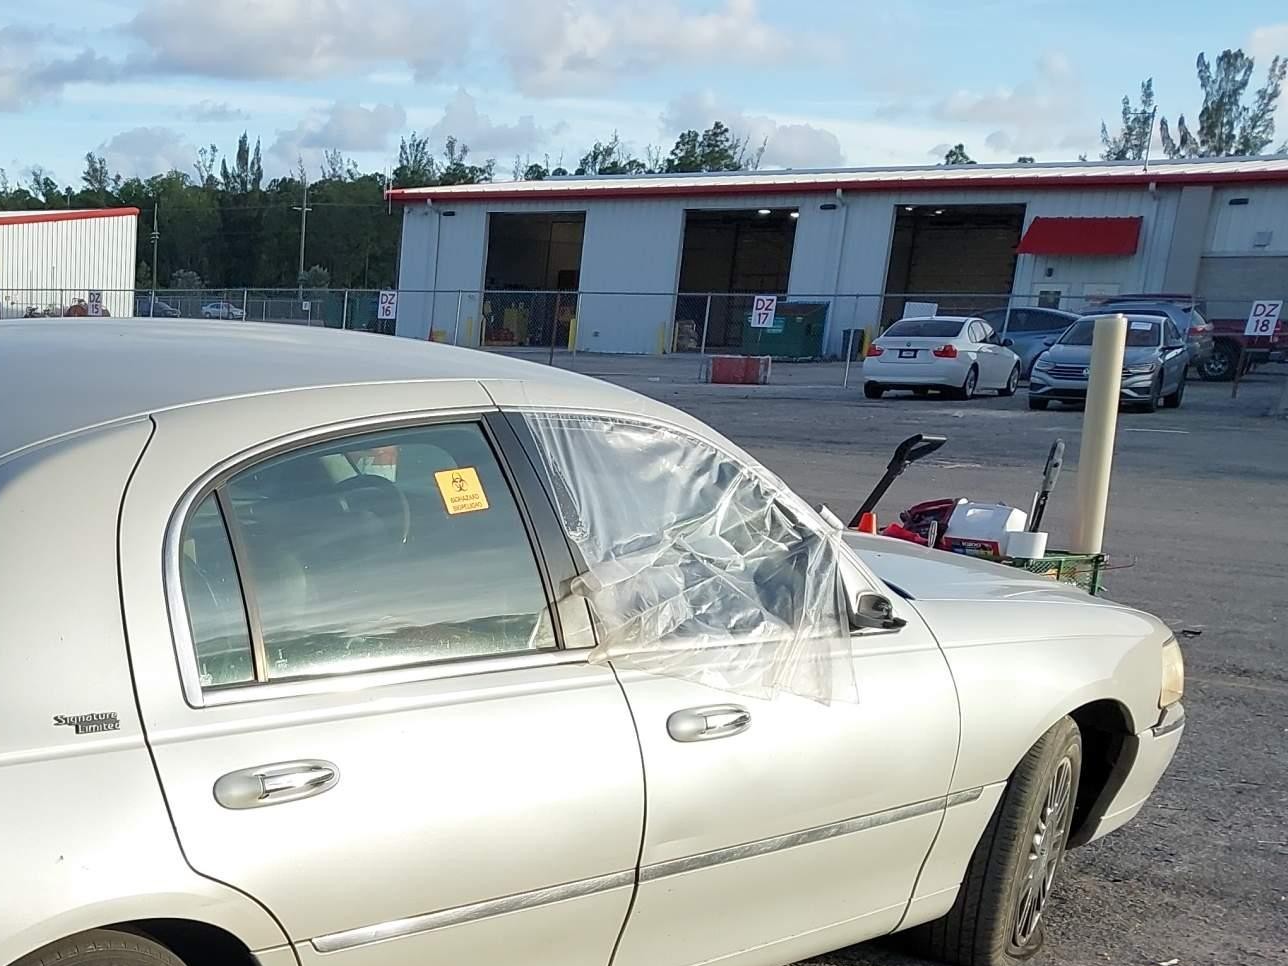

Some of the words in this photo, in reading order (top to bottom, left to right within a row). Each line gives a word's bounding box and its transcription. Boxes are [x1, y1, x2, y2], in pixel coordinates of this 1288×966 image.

[89, 292, 101, 303] DZ
[380, 293, 396, 305] DZ
[91, 303, 100, 314] 15
[382, 305, 391, 317] 16
[755, 298, 775, 311] DZ
[1252, 303, 1280, 317] DZ
[757, 312, 769, 325] 17
[1253, 319, 1270, 333] 18
[53, 712, 118, 727] Signature
[75, 719, 121, 735] Limited
